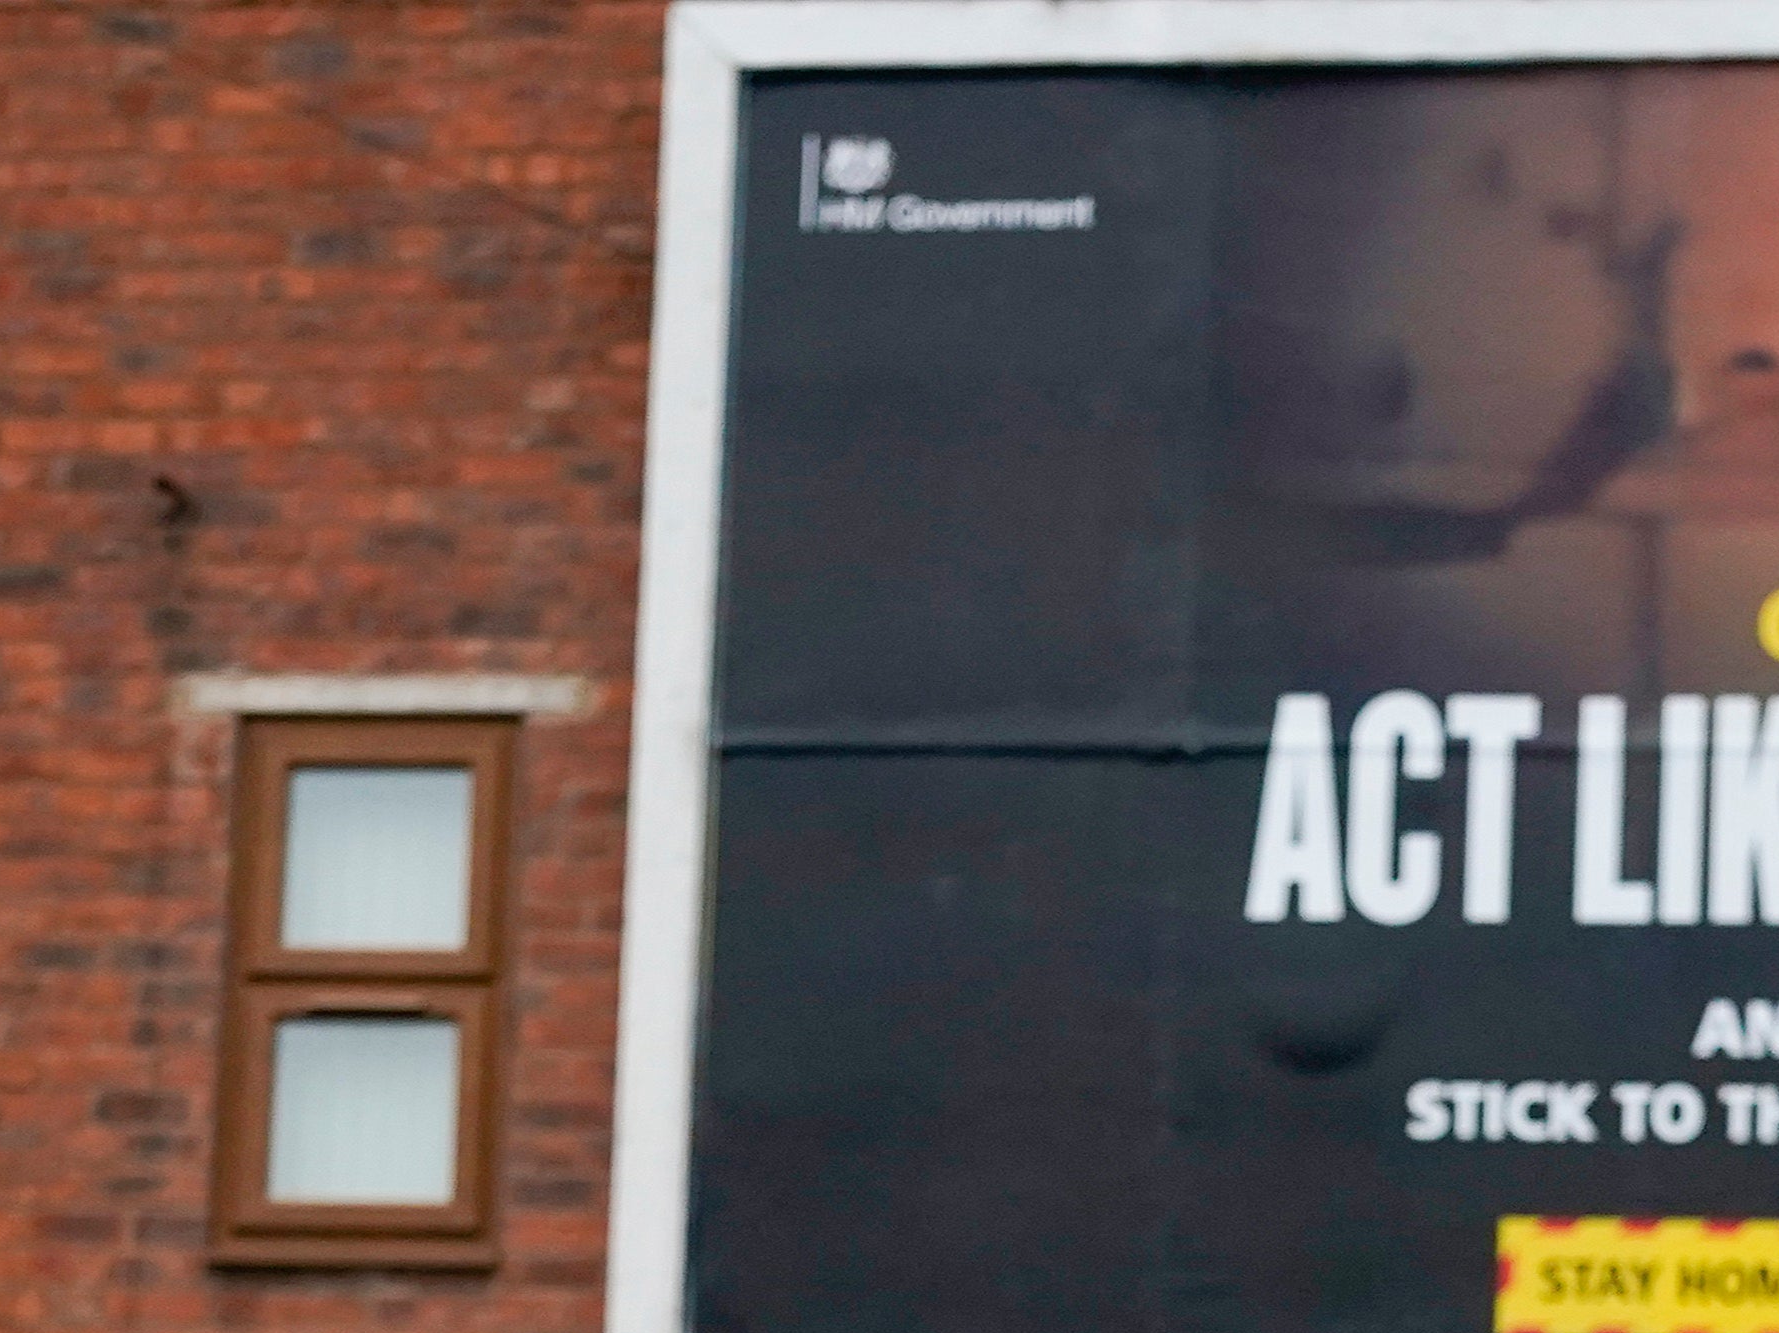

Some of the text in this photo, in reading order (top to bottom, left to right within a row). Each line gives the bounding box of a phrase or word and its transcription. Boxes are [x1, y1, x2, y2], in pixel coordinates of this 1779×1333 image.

[1244, 690, 1542, 926] ACT
[1405, 1078, 1598, 1143] STICK
[1611, 1080, 1707, 1144] TO
[1536, 1256, 1658, 1304] STAY
